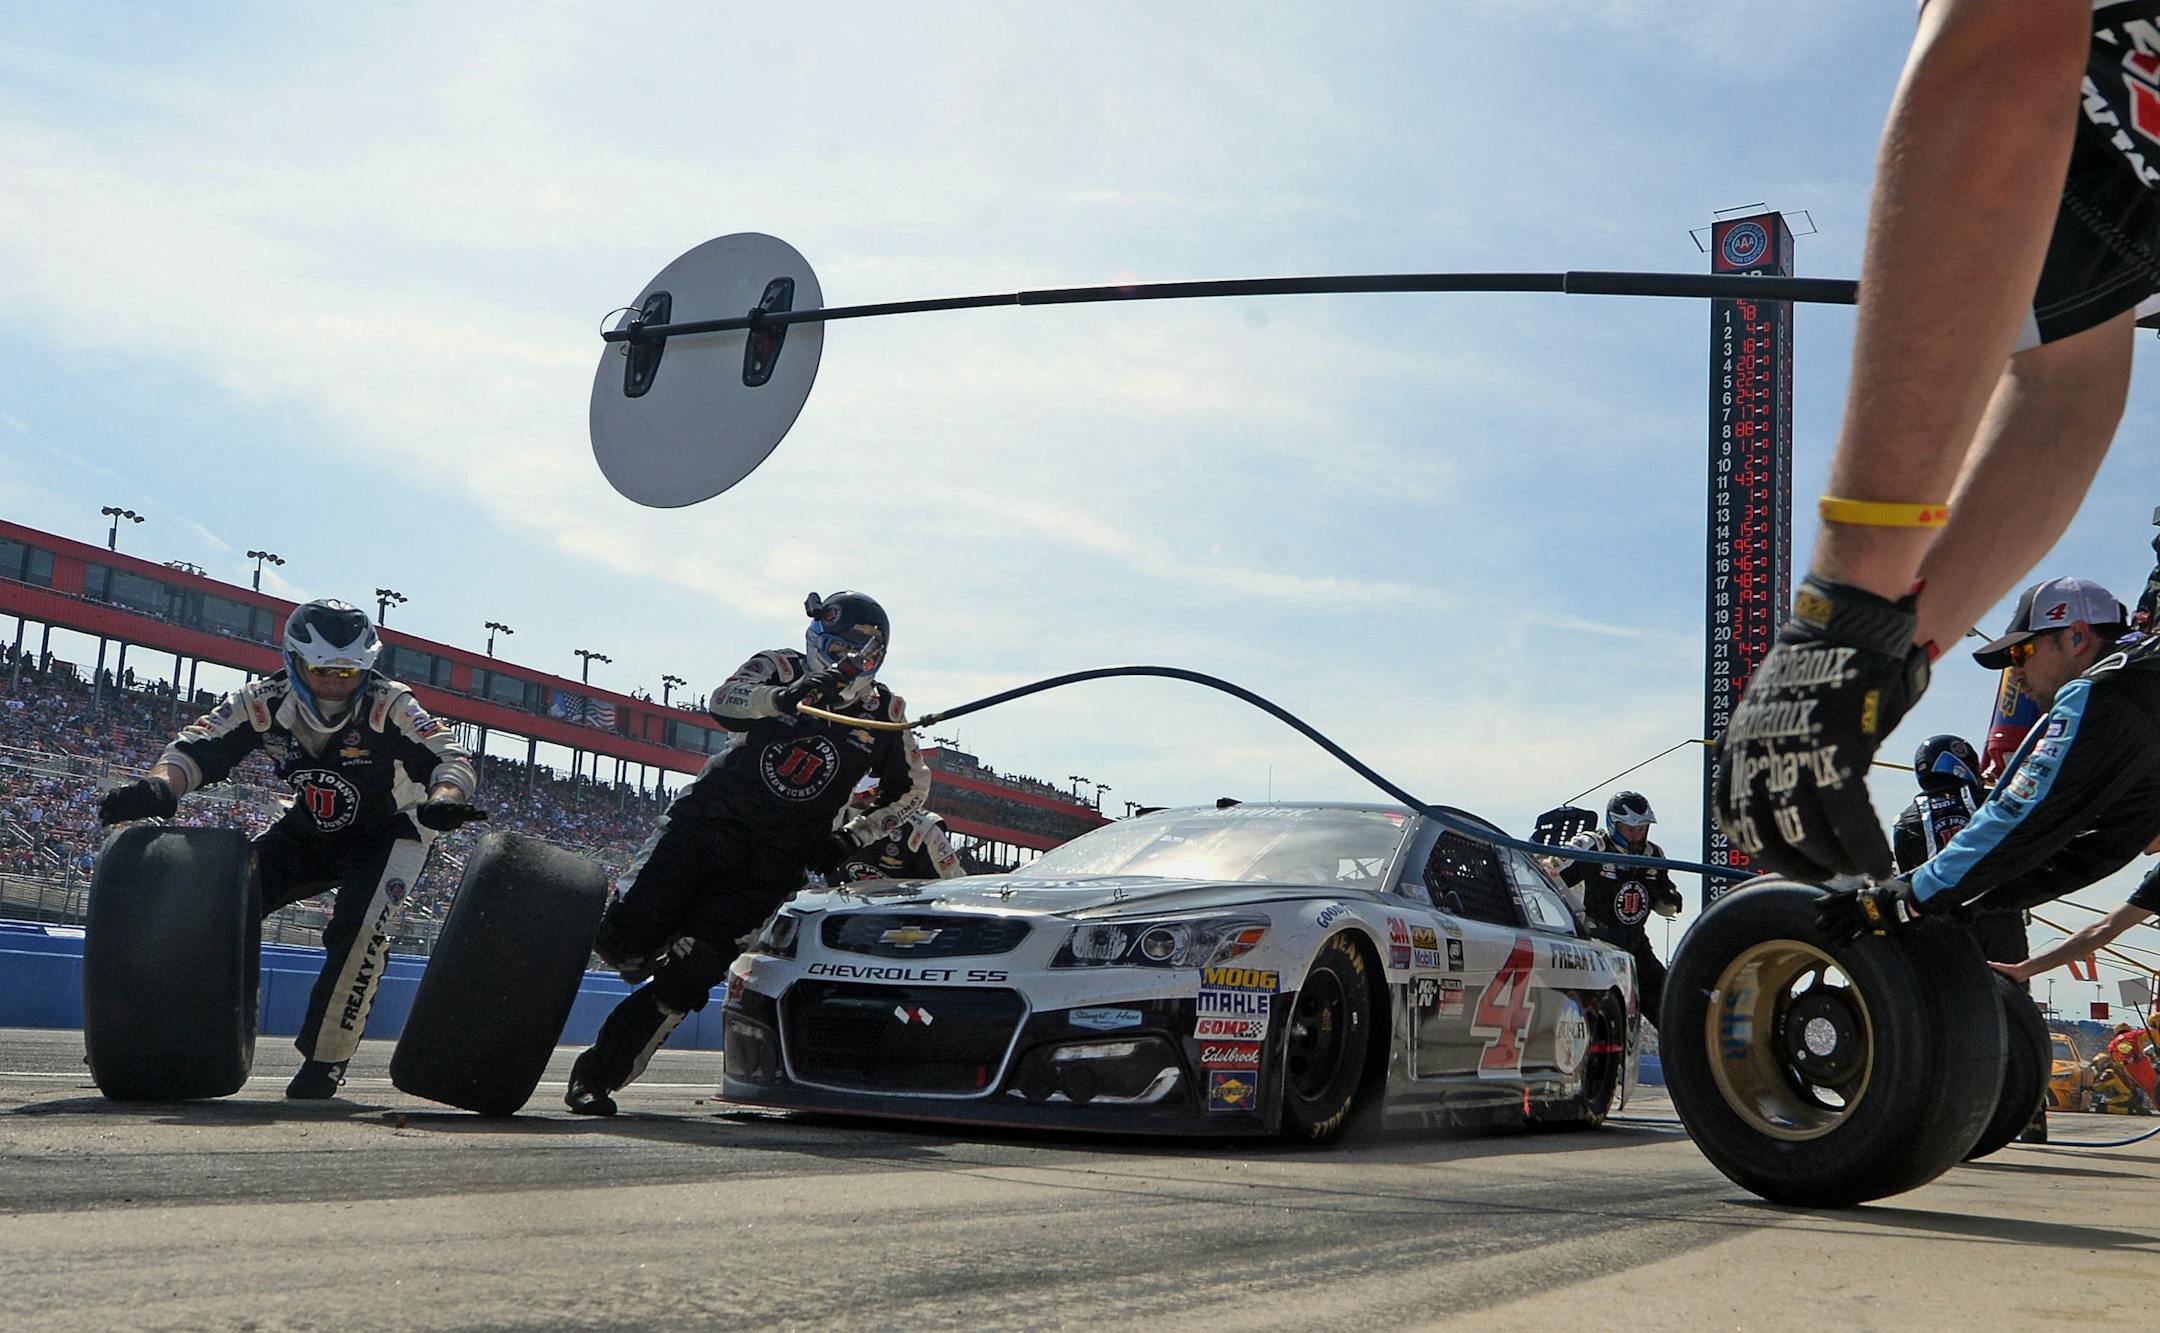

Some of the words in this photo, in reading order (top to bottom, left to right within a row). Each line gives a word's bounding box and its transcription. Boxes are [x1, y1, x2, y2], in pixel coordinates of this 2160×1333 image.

[1735, 237, 1754, 249] AAA
[1724, 310, 1730, 323] 1
[1739, 305, 1756, 320] 78
[1724, 327, 1732, 339] 2
[1724, 343, 1732, 356] 3
[1723, 359, 1732, 371] 4
[1723, 376, 1731, 388] 5
[1723, 392, 1731, 405] 6
[1723, 409, 1731, 421] 7
[1722, 425, 1731, 438] 8
[1722, 442, 1731, 455] 9
[1717, 459, 1731, 472] 10
[1717, 476, 1727, 489] 11
[1716, 493, 1729, 506] 12
[1716, 509, 1729, 522] 13
[1716, 526, 1729, 538] 14
[1716, 543, 1729, 555] 15
[1716, 559, 1729, 572] 16
[1715, 577, 1728, 589] 17
[1715, 593, 1729, 606] 18
[1715, 610, 1728, 623] 19
[2046, 603, 2066, 620] 4
[1714, 628, 1731, 640] 20
[1714, 644, 1728, 657] 21
[1714, 661, 1729, 674] 22
[1713, 679, 1729, 692] 23
[1713, 696, 1729, 709] 24
[1713, 712, 1728, 726] 25
[1711, 834, 1728, 847] 32
[1711, 852, 1728, 865] 33
[1388, 916, 1409, 944] 3M
[808, 963, 957, 981] CHEVROLET
[966, 970, 1008, 981] SS
[1203, 967, 1277, 989] MOOG
[340, 958, 375, 1031] FREAKY
[1198, 992, 1268, 1014] MAHLE
[1471, 934, 1534, 1078] 4
[1199, 1020, 1249, 1035] COMP
[1201, 1046, 1260, 1064] Edelbrock
[1212, 1086, 1253, 1098] SUNOCO
